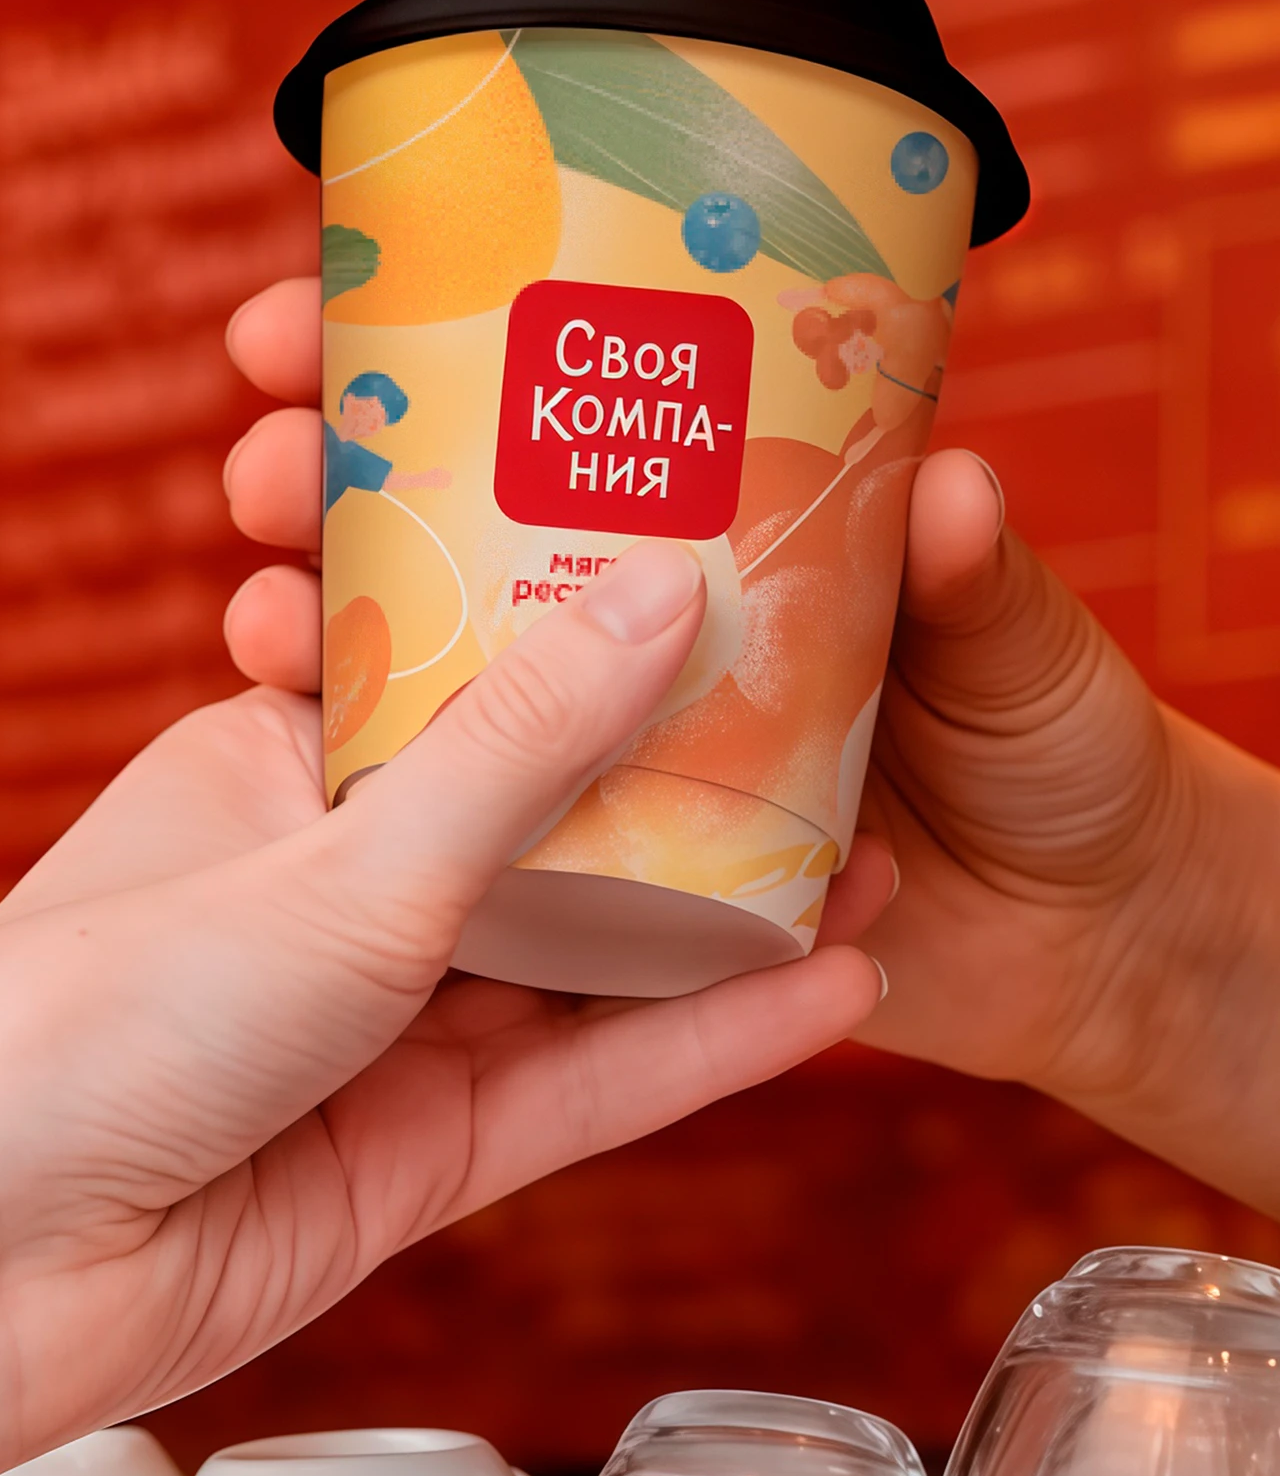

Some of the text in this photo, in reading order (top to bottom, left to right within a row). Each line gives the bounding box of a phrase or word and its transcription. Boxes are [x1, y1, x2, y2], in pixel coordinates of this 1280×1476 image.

[556, 319, 698, 389] Своя
[569, 451, 670, 499] ния
[549, 553, 617, 576] мяг
[512, 580, 584, 607] рес
